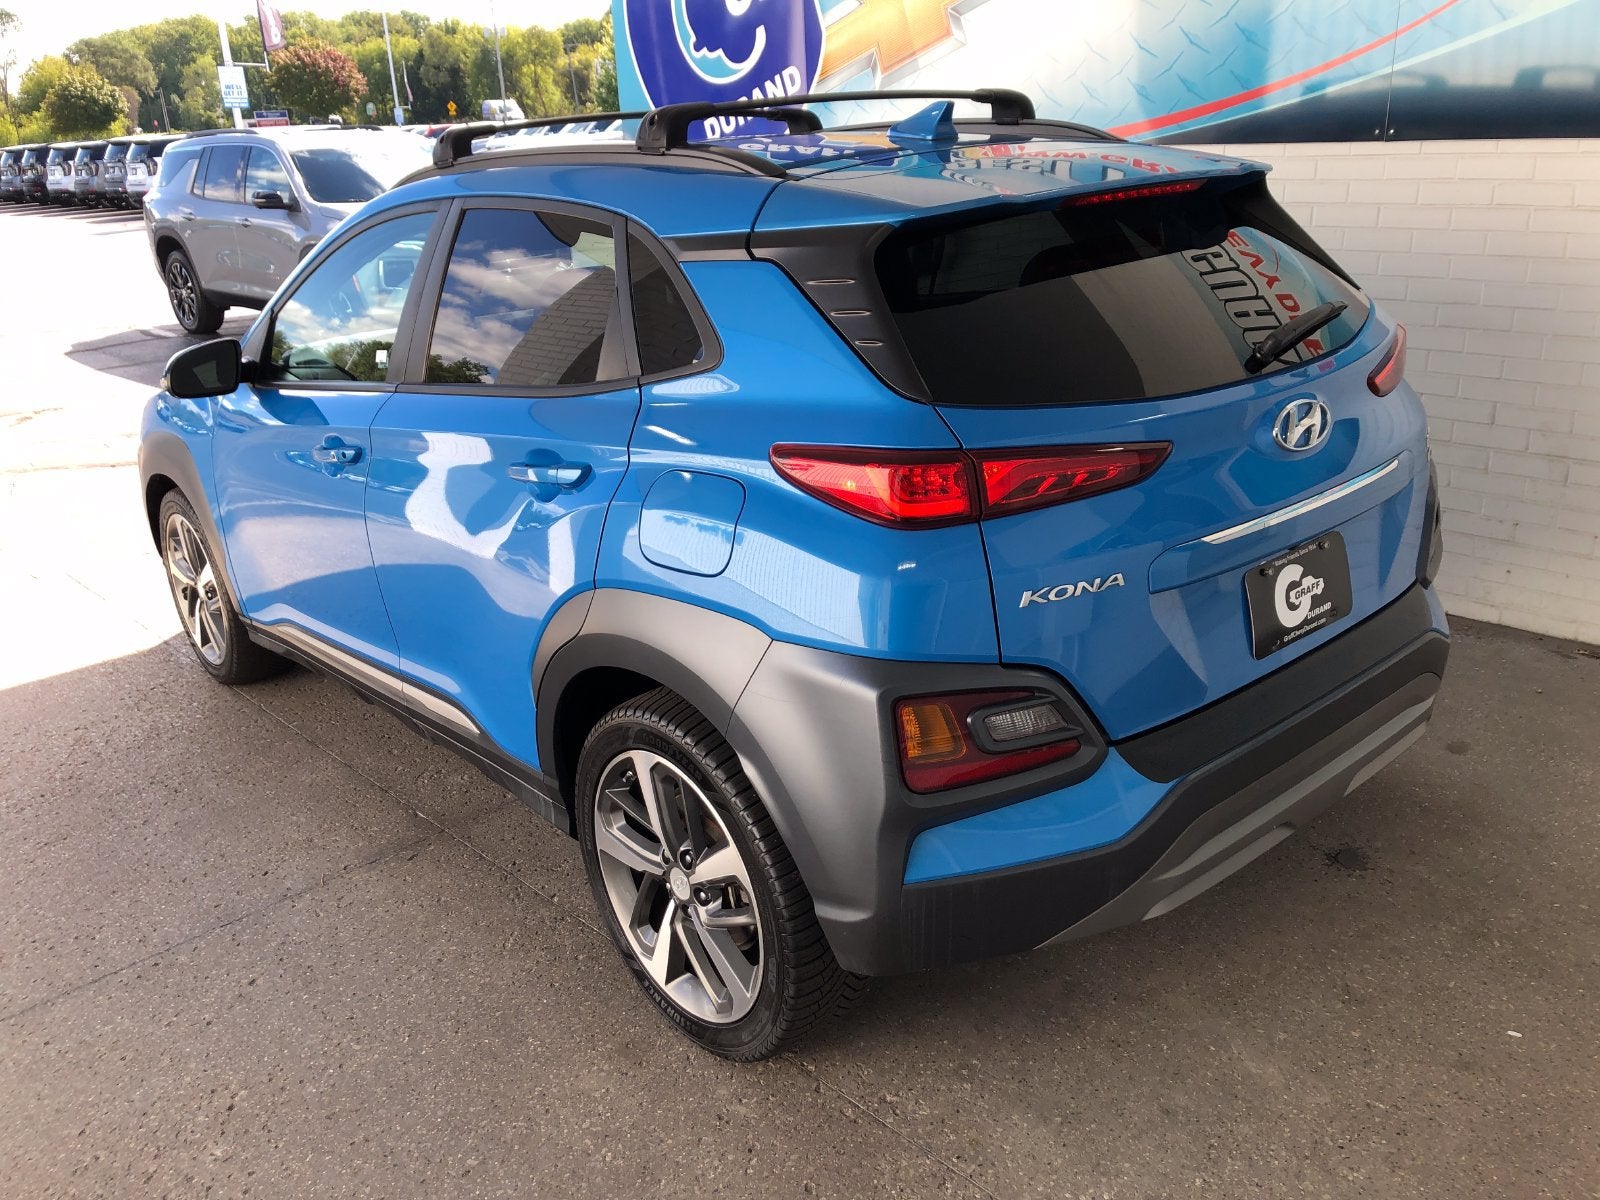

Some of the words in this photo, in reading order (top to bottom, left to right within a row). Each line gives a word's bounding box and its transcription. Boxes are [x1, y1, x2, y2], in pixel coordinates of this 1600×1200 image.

[1019, 572, 1125, 608] KONA
[1294, 580, 1321, 600] GRAFF
[1307, 602, 1332, 619] DURAND
